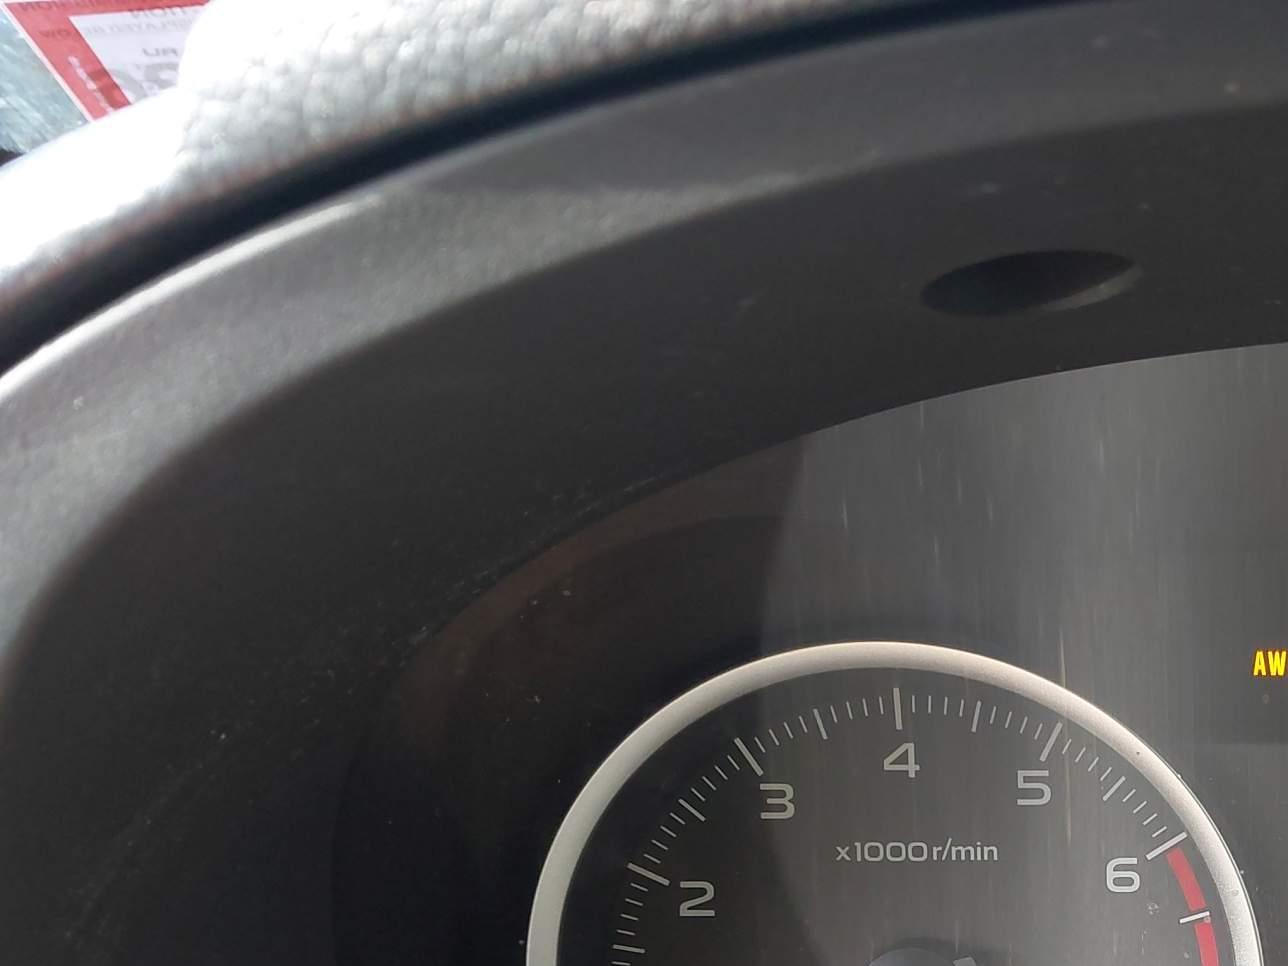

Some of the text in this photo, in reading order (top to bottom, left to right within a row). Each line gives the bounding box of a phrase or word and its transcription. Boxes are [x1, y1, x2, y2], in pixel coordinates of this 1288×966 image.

[884, 743, 920, 778] 4
[760, 784, 794, 819] 3
[1017, 770, 1051, 805] 5
[836, 838, 997, 861] x1000 r/min
[1107, 858, 1140, 892] 6
[680, 881, 715, 916] 2
